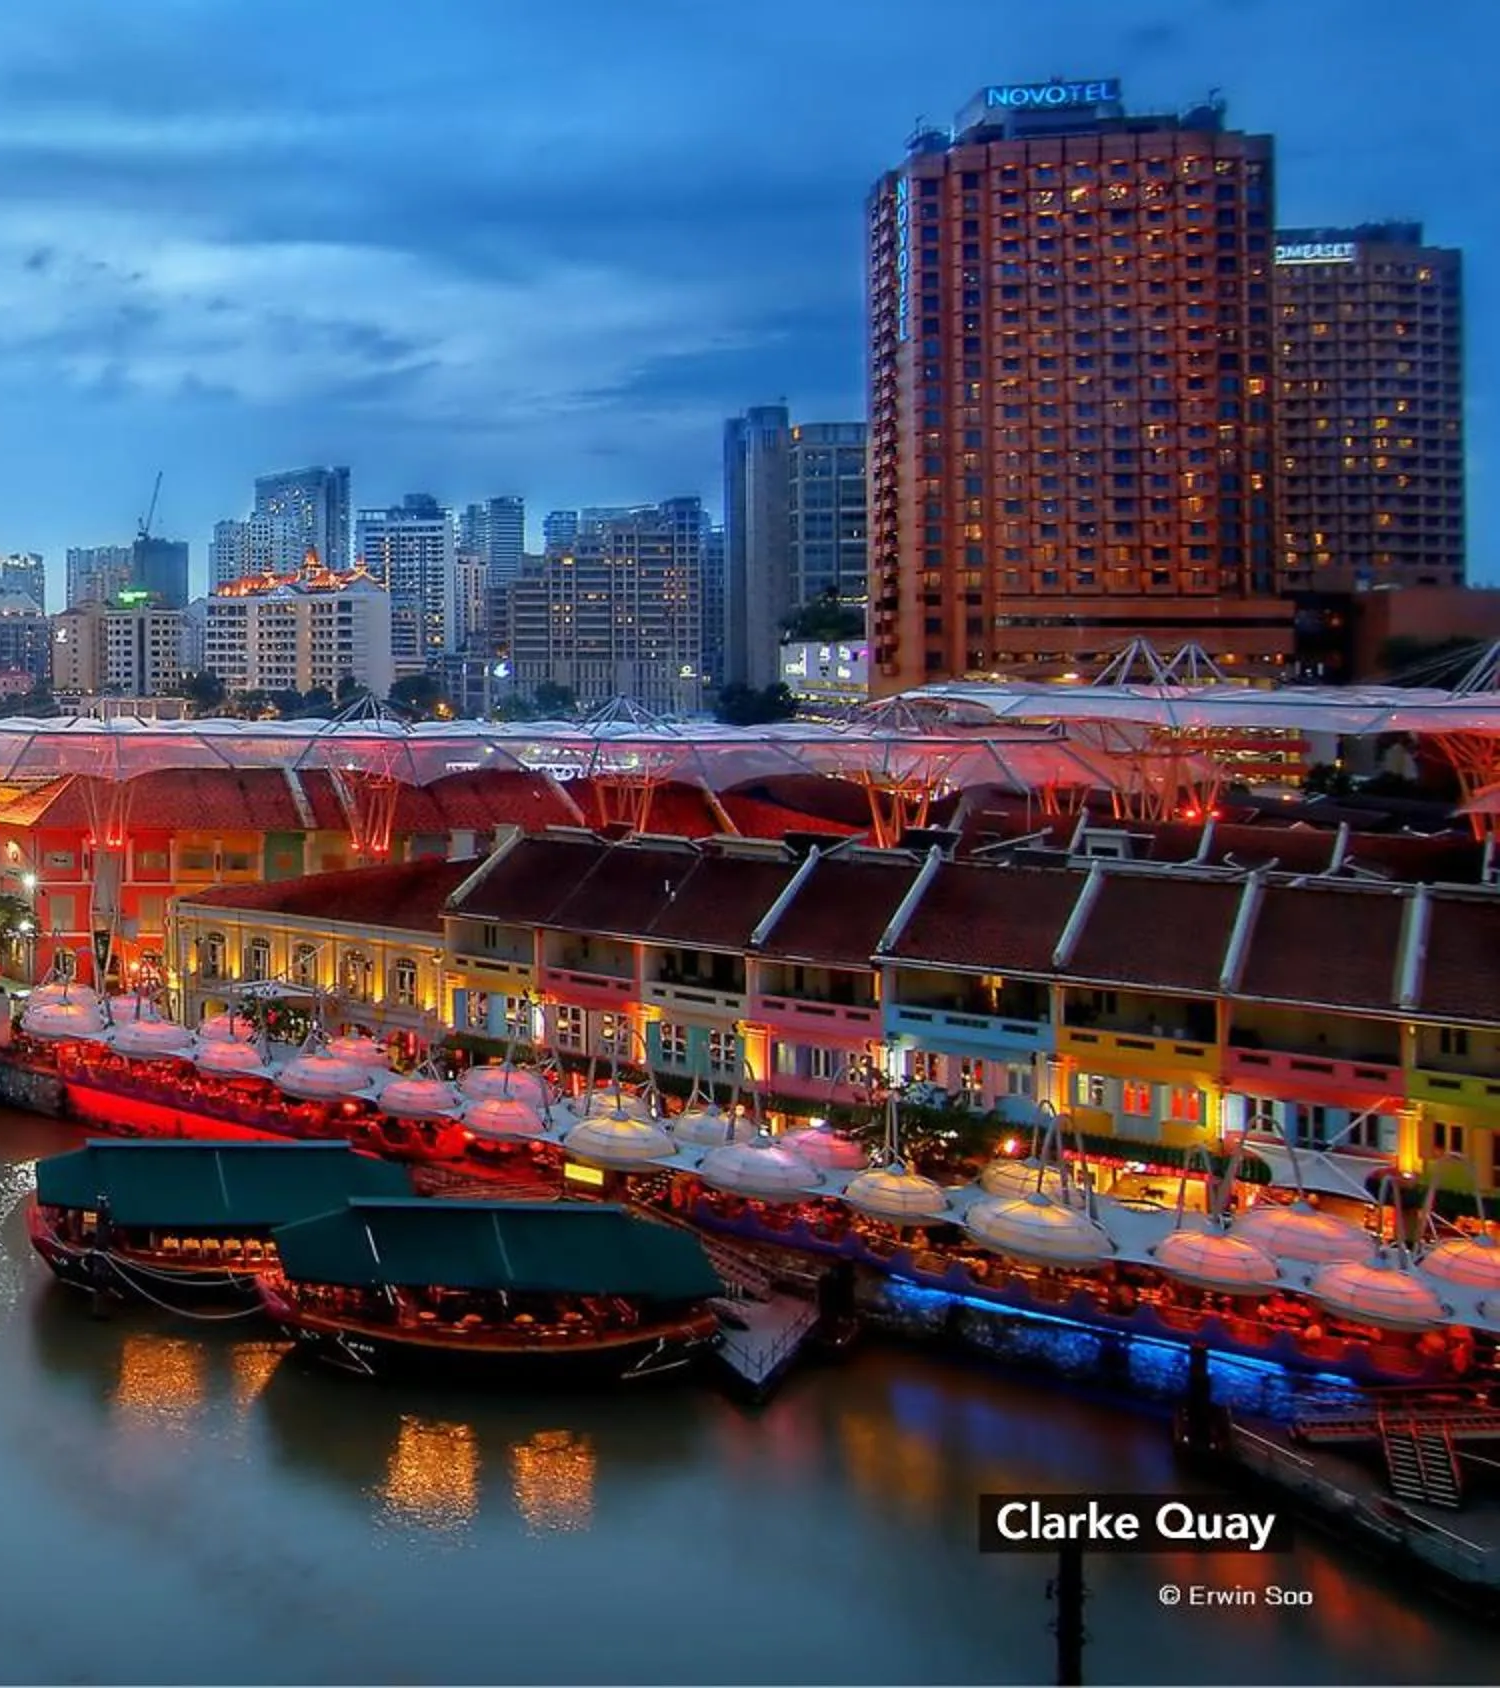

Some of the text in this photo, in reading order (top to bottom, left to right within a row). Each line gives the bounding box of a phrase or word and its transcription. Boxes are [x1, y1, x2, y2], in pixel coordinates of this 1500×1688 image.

[987, 82, 1116, 107] NOVOTEL
[898, 177, 909, 342] NOVOTEL
[1275, 243, 1356, 259] OMERSET
